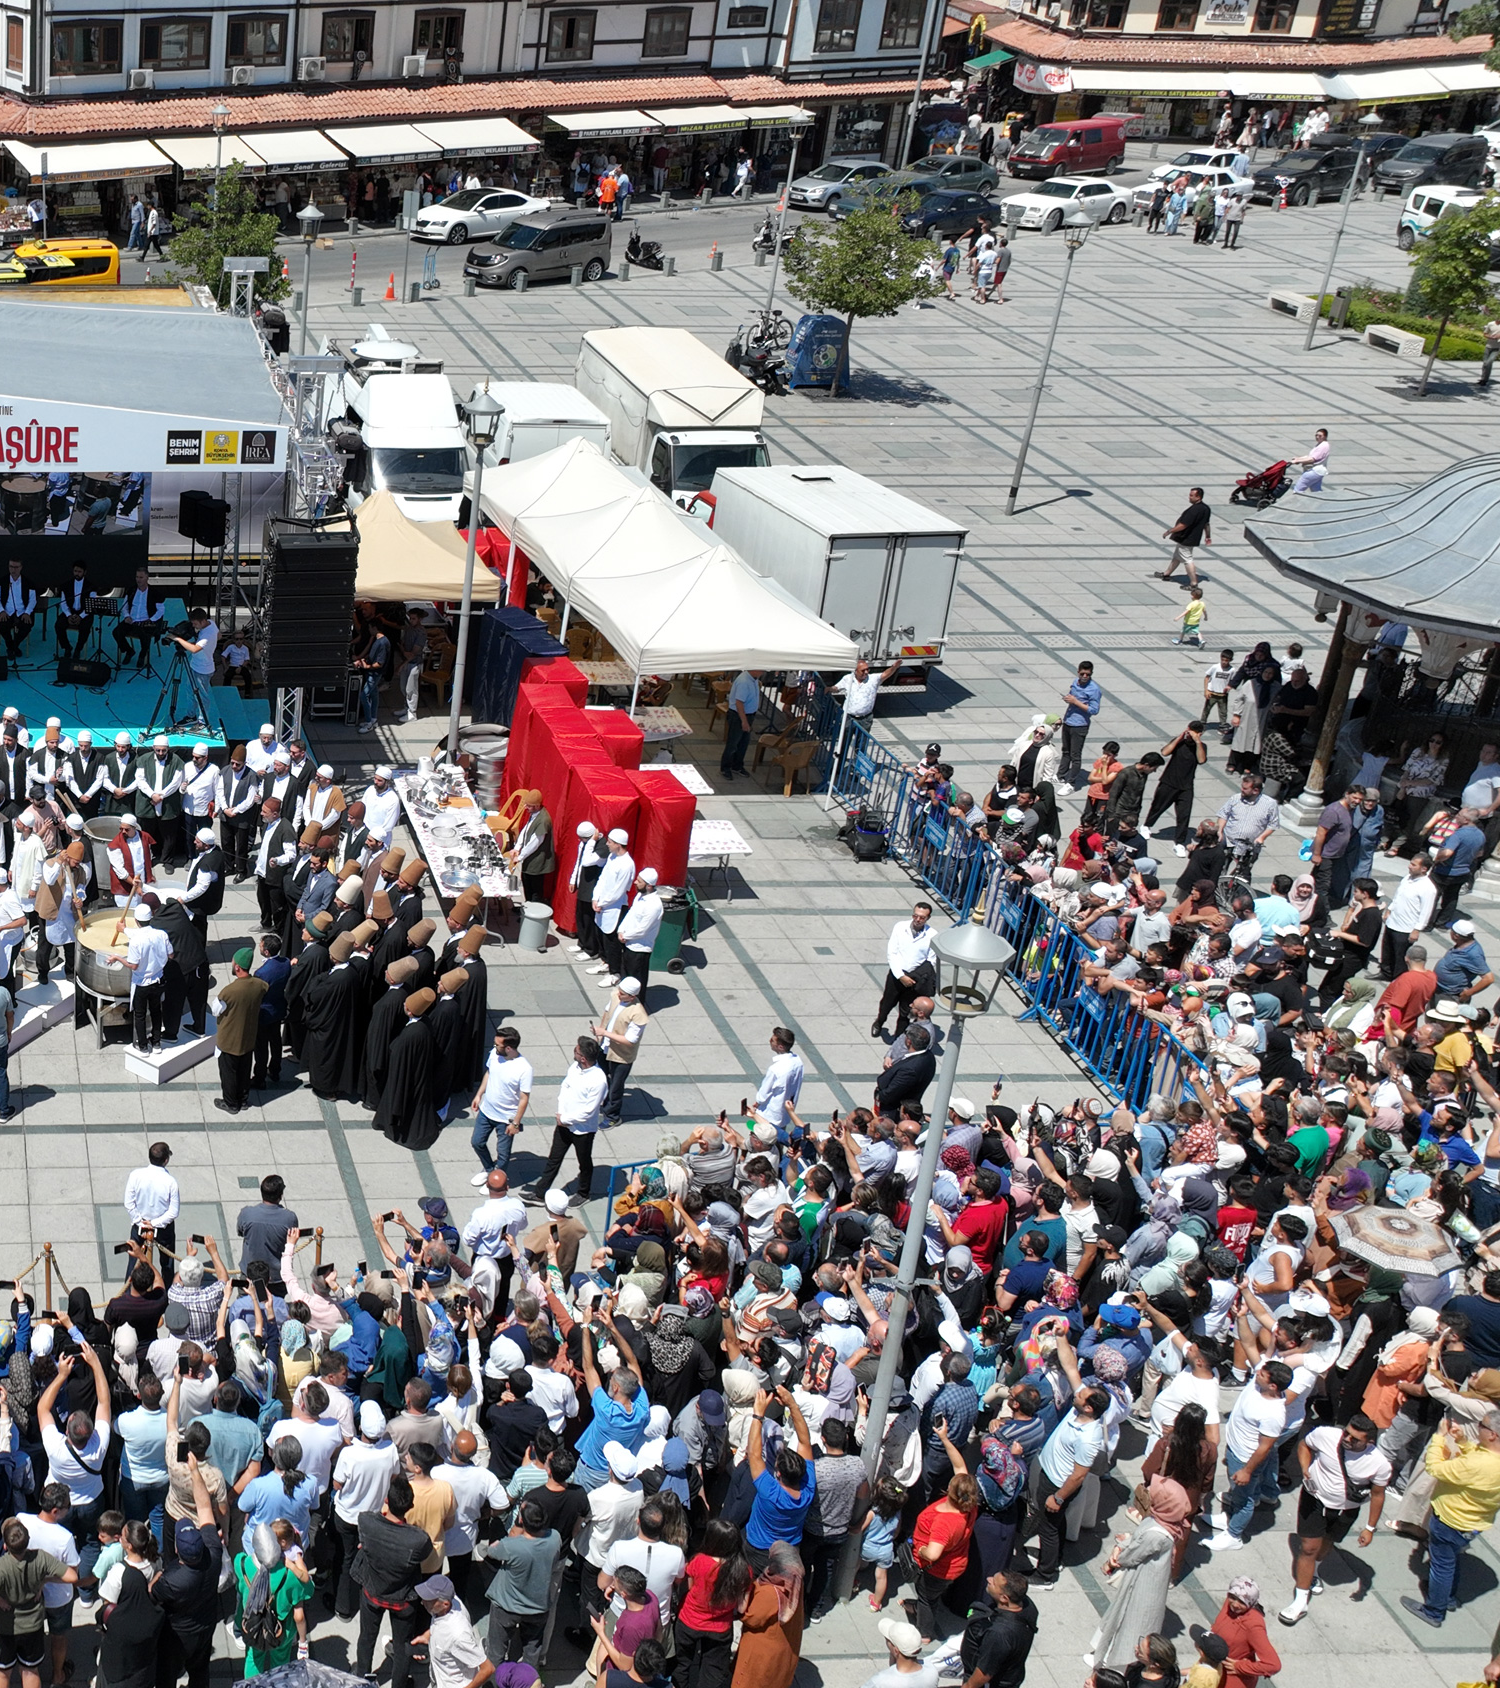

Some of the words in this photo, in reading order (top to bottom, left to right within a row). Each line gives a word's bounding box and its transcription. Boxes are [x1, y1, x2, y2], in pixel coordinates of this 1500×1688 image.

[704, 121, 746, 131] ŞEKERLEME
[293, 163, 314, 171] Sanat
[169, 438, 200, 448] BENİM
[169, 447, 199, 457] ŞEHRİM
